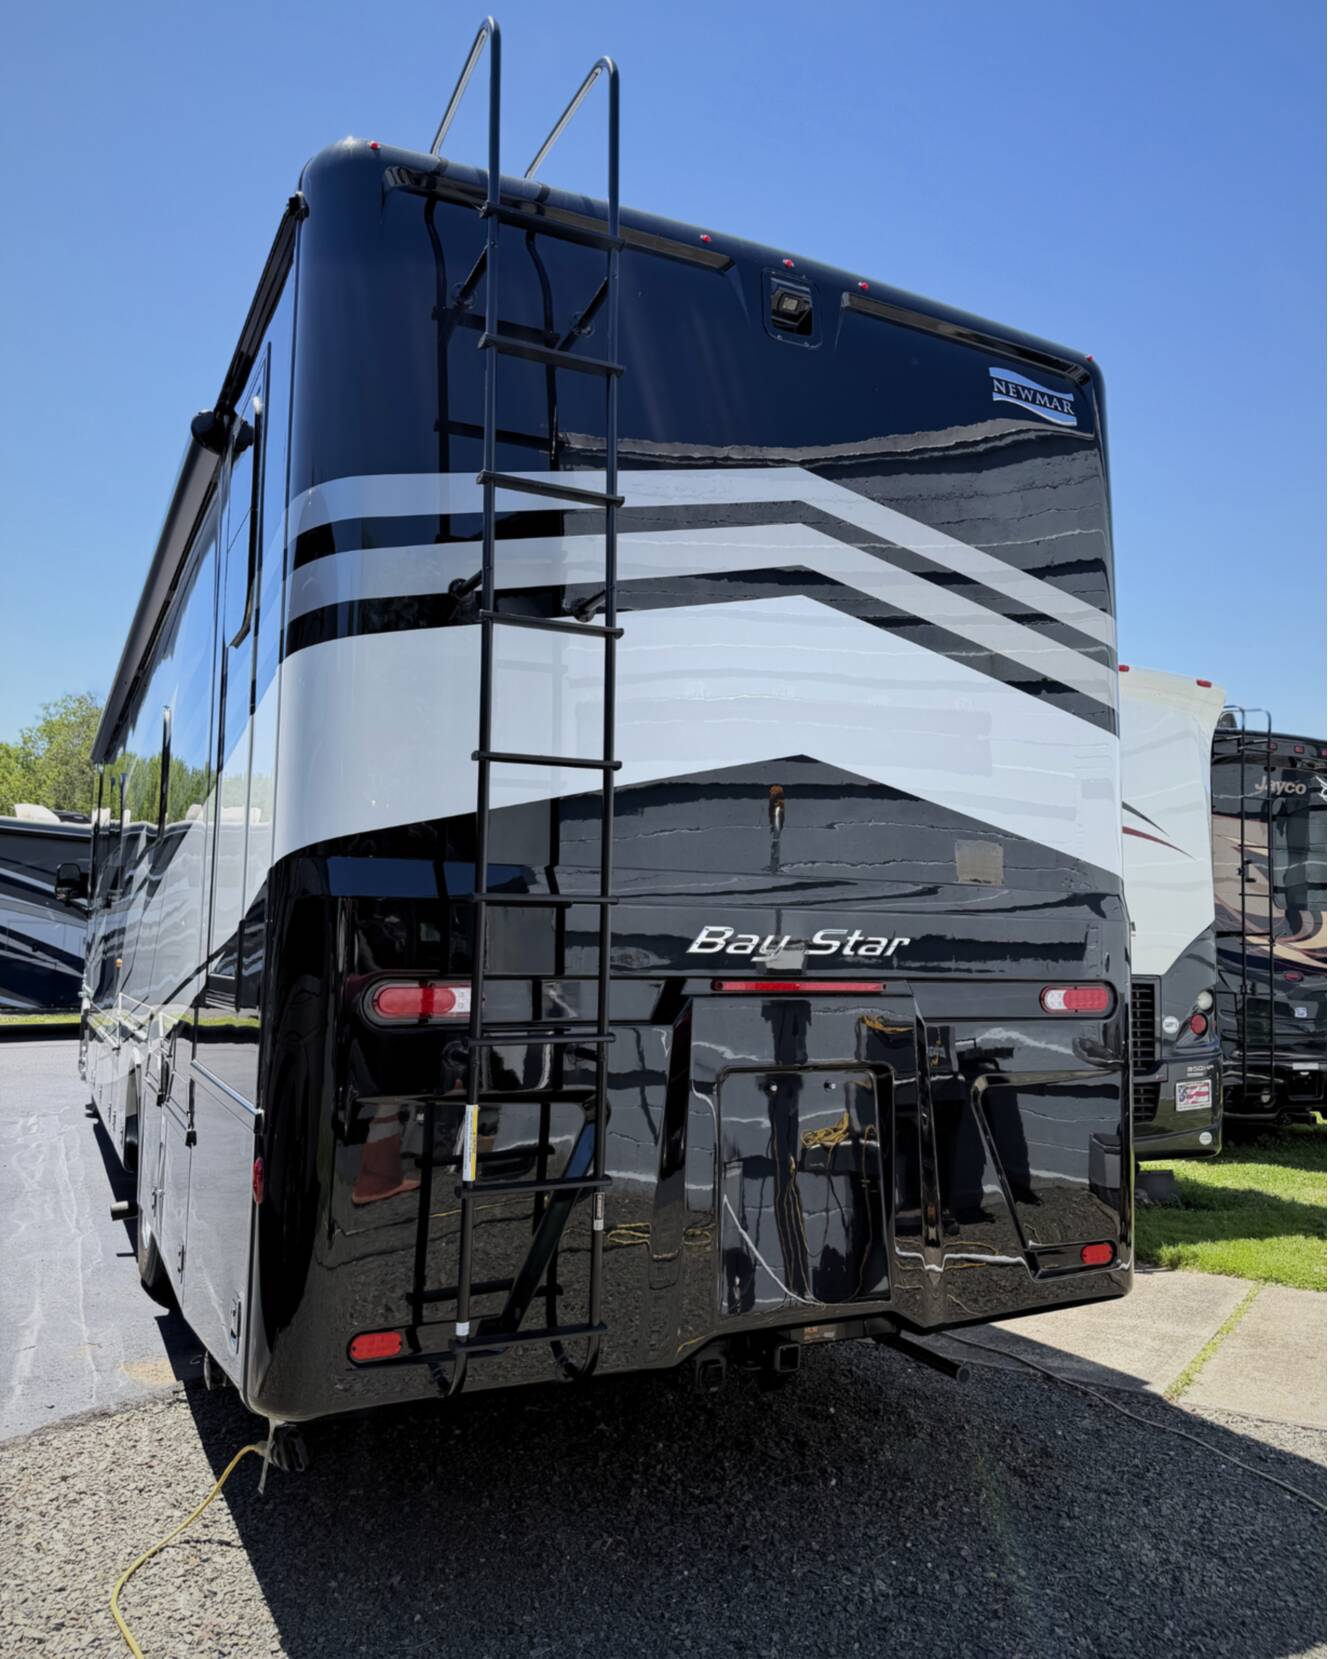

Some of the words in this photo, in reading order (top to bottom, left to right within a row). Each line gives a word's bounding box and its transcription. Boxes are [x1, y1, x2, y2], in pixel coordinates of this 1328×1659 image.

[993, 379, 1075, 415] NEWMAR
[686, 925, 791, 962] Bay
[804, 928, 911, 957] Star
